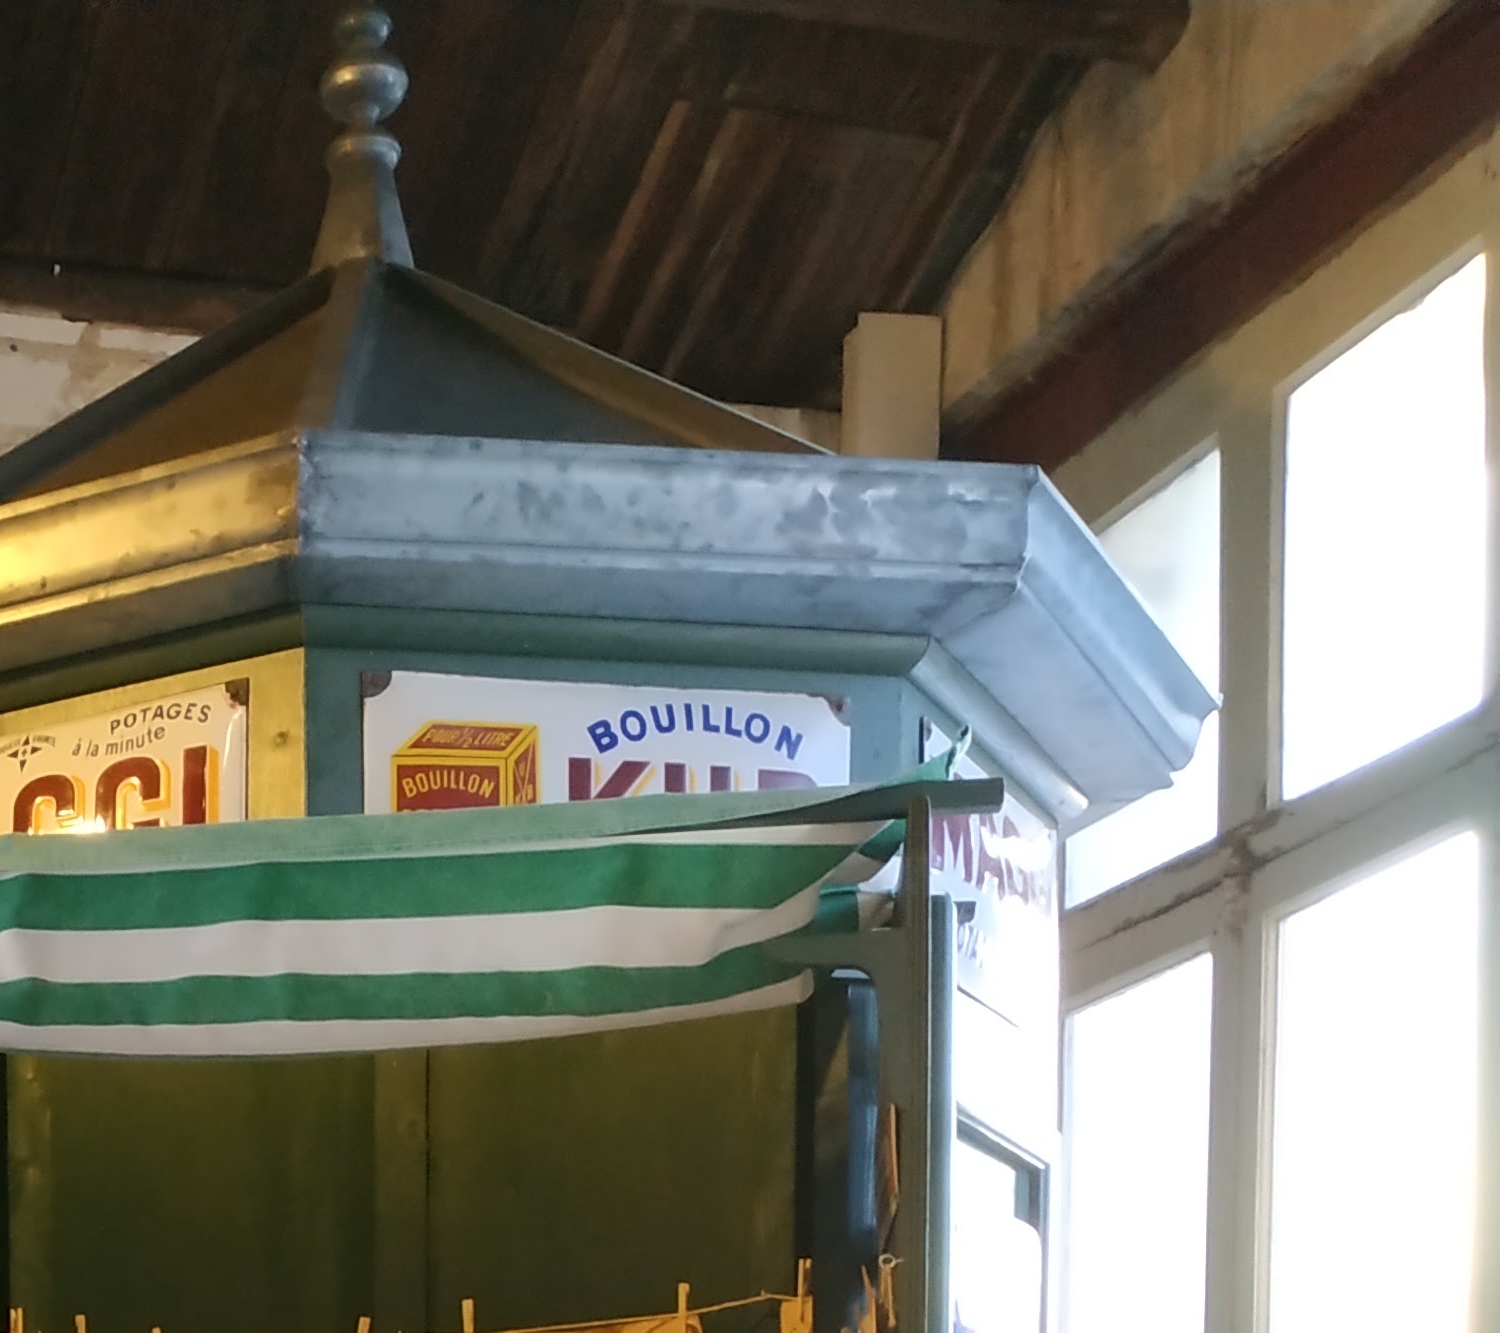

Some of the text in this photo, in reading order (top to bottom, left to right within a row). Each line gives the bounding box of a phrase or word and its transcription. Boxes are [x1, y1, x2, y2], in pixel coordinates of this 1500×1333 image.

[110, 703, 211, 734] POTAGES
[587, 703, 804, 760] BOUILLON
[86, 738, 100, 757] la
[105, 725, 166, 756] minute
[422, 728, 458, 744] POUR
[474, 731, 514, 746] LITRE
[402, 769, 495, 798] BOUILLON
